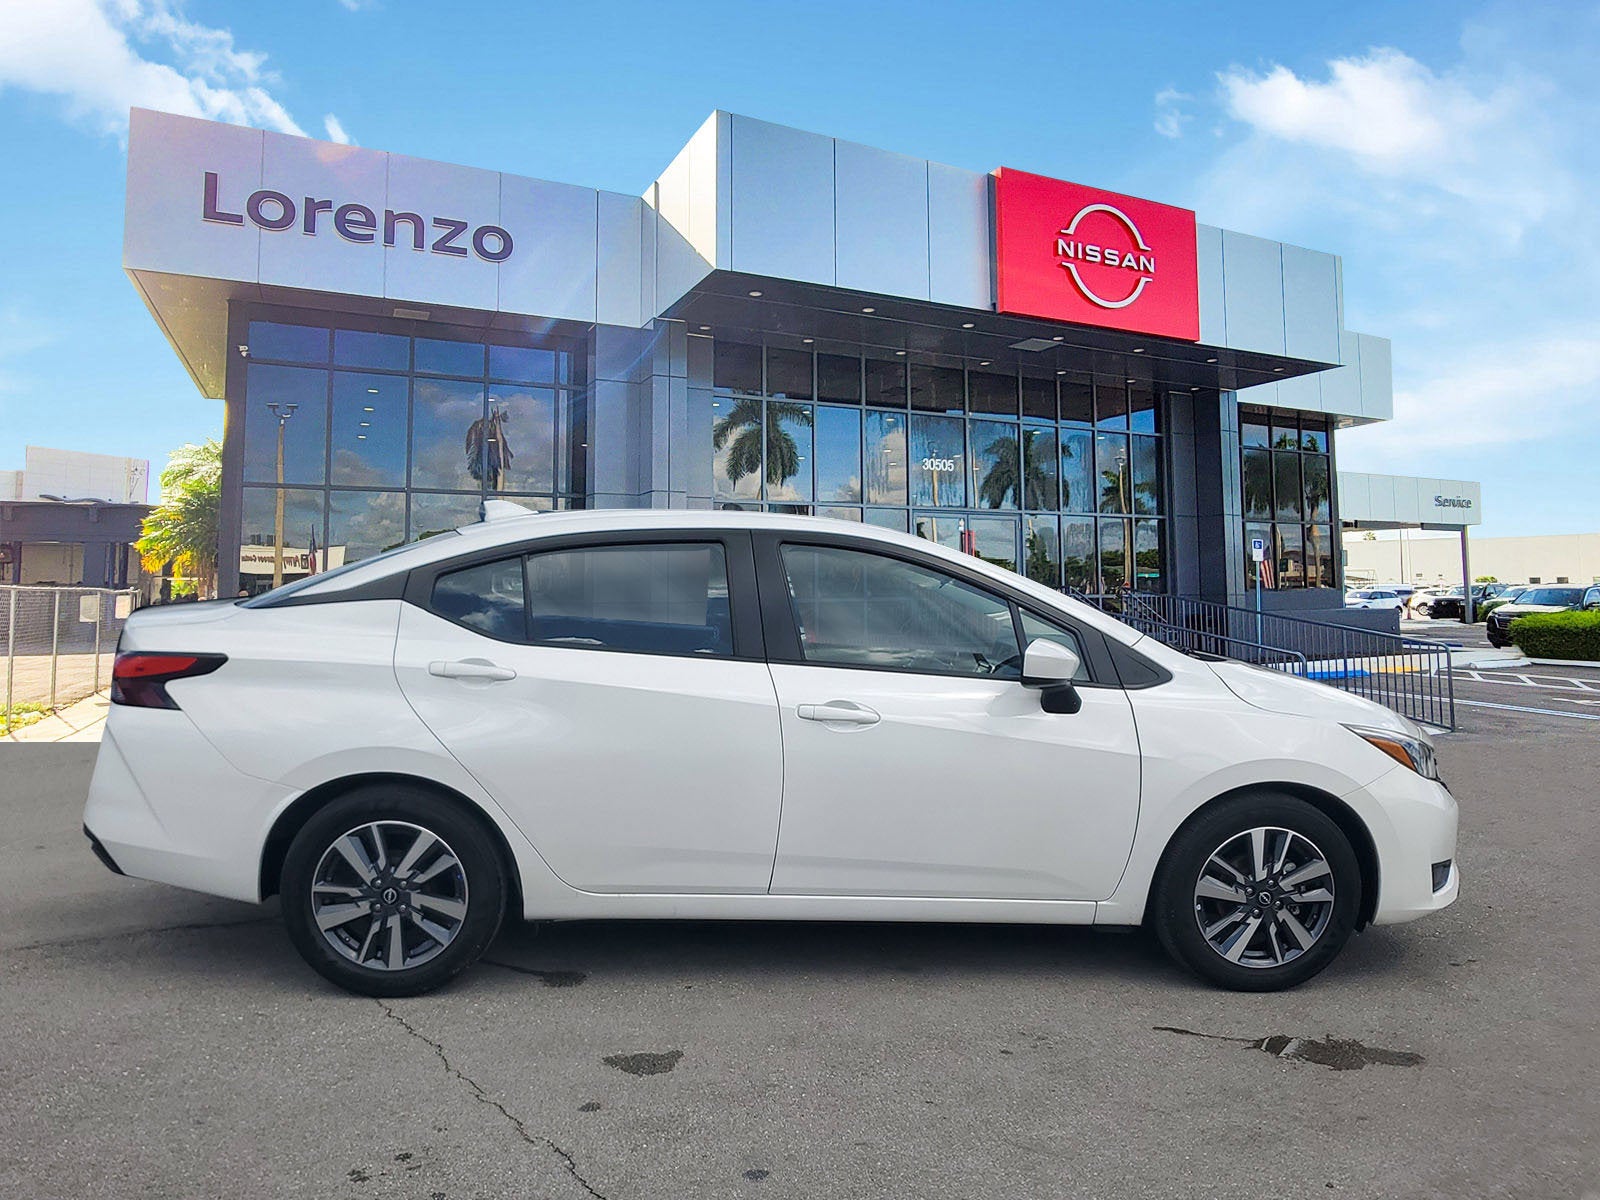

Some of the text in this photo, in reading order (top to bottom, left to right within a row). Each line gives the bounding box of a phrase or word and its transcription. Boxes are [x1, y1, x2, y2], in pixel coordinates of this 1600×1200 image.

[203, 171, 514, 262] Lorenzo
[1057, 238, 1155, 273] NISSAN
[922, 458, 954, 471] 30505
[1434, 496, 1472, 508] Service
